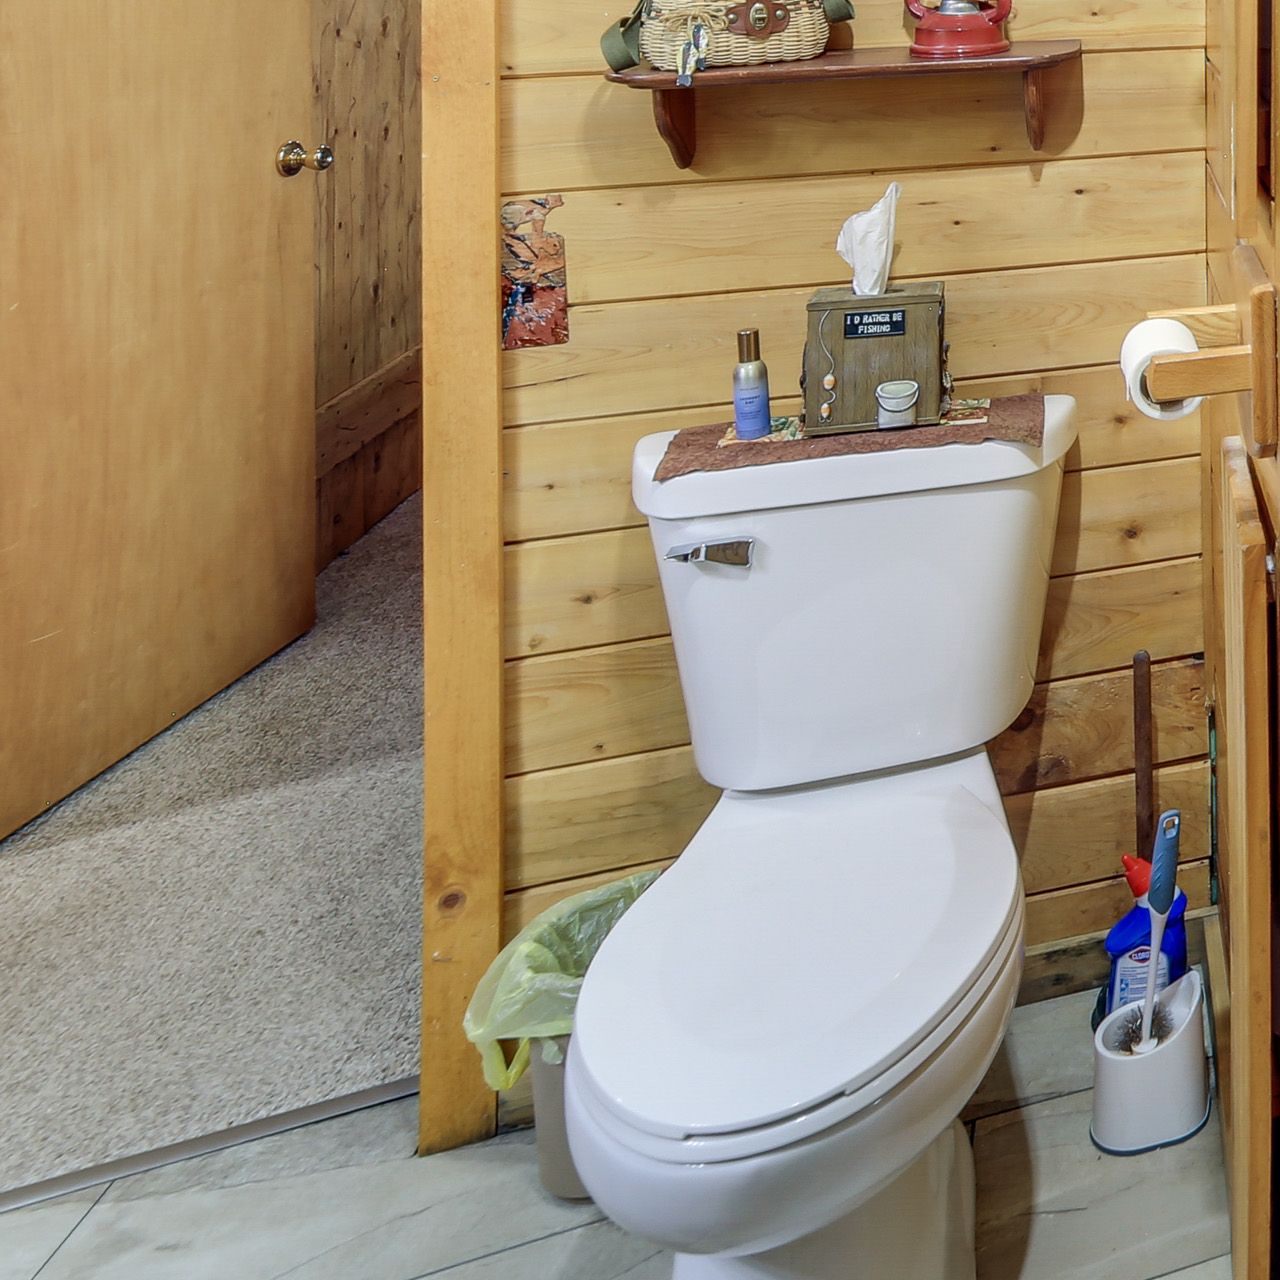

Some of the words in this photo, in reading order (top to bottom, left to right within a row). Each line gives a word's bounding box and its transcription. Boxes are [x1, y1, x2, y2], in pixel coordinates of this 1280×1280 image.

[862, 313, 890, 324] RATHER
[892, 312, 903, 322] BE
[857, 324, 891, 334] FISHING
